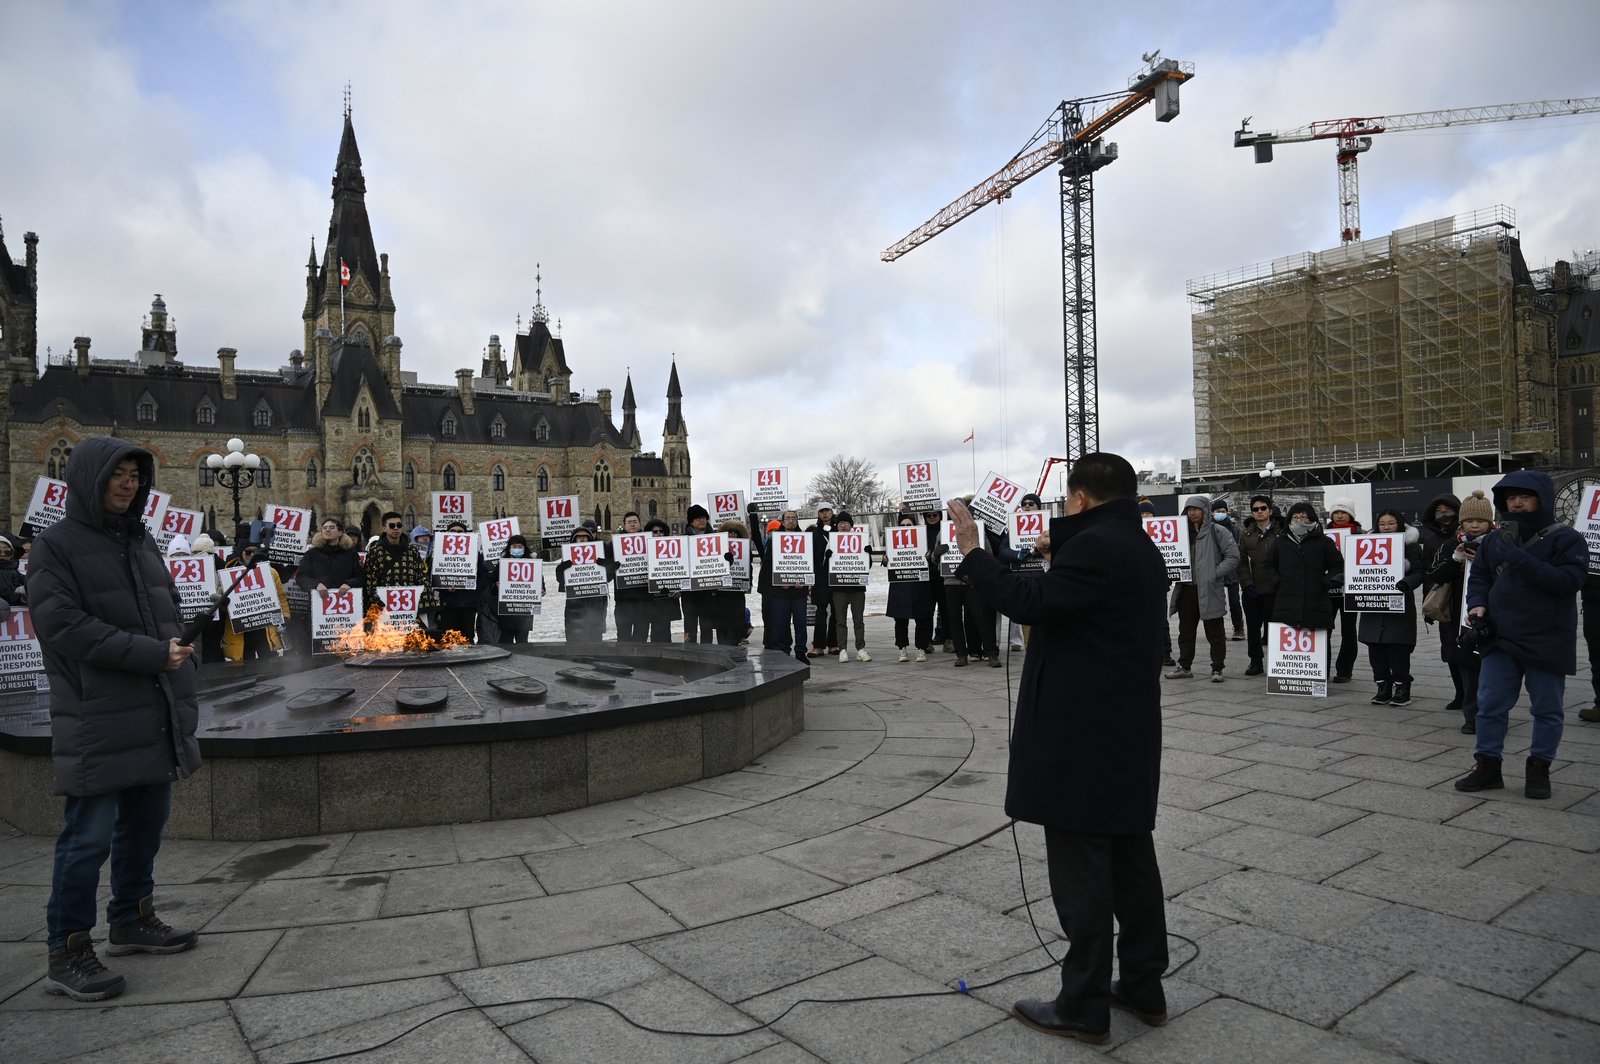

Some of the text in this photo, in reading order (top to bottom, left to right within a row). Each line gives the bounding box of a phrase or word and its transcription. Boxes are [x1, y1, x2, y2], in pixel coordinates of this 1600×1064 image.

[761, 470, 778, 486] 41
[909, 464, 928, 482] 33
[989, 478, 1016, 502] 20
[43, 506, 66, 516] MONTH
[442, 496, 461, 512] 43
[550, 499, 568, 518] 17
[717, 494, 736, 512] 28
[979, 498, 998, 510] WAITING
[986, 495, 1005, 508] MONTHS
[165, 511, 191, 534] 37
[275, 509, 299, 531] 27
[983, 506, 1006, 520] RESPONSE
[489, 522, 510, 540] 35
[1019, 514, 1040, 535] 22
[1150, 520, 1175, 543] 39
[445, 536, 467, 554] 33
[623, 536, 644, 555] 30
[699, 536, 719, 556] 31
[783, 535, 802, 553] 37
[839, 535, 859, 553] 40
[895, 529, 914, 548] 11
[573, 545, 594, 565] 32
[658, 539, 678, 559] 20
[1360, 539, 1388, 565] 25
[174, 560, 200, 582] 23
[511, 562, 532, 581] 90
[326, 592, 350, 614] 25
[389, 590, 412, 611] 33
[1283, 627, 1312, 652] 36
[4, 660, 42, 670] RESPONS
